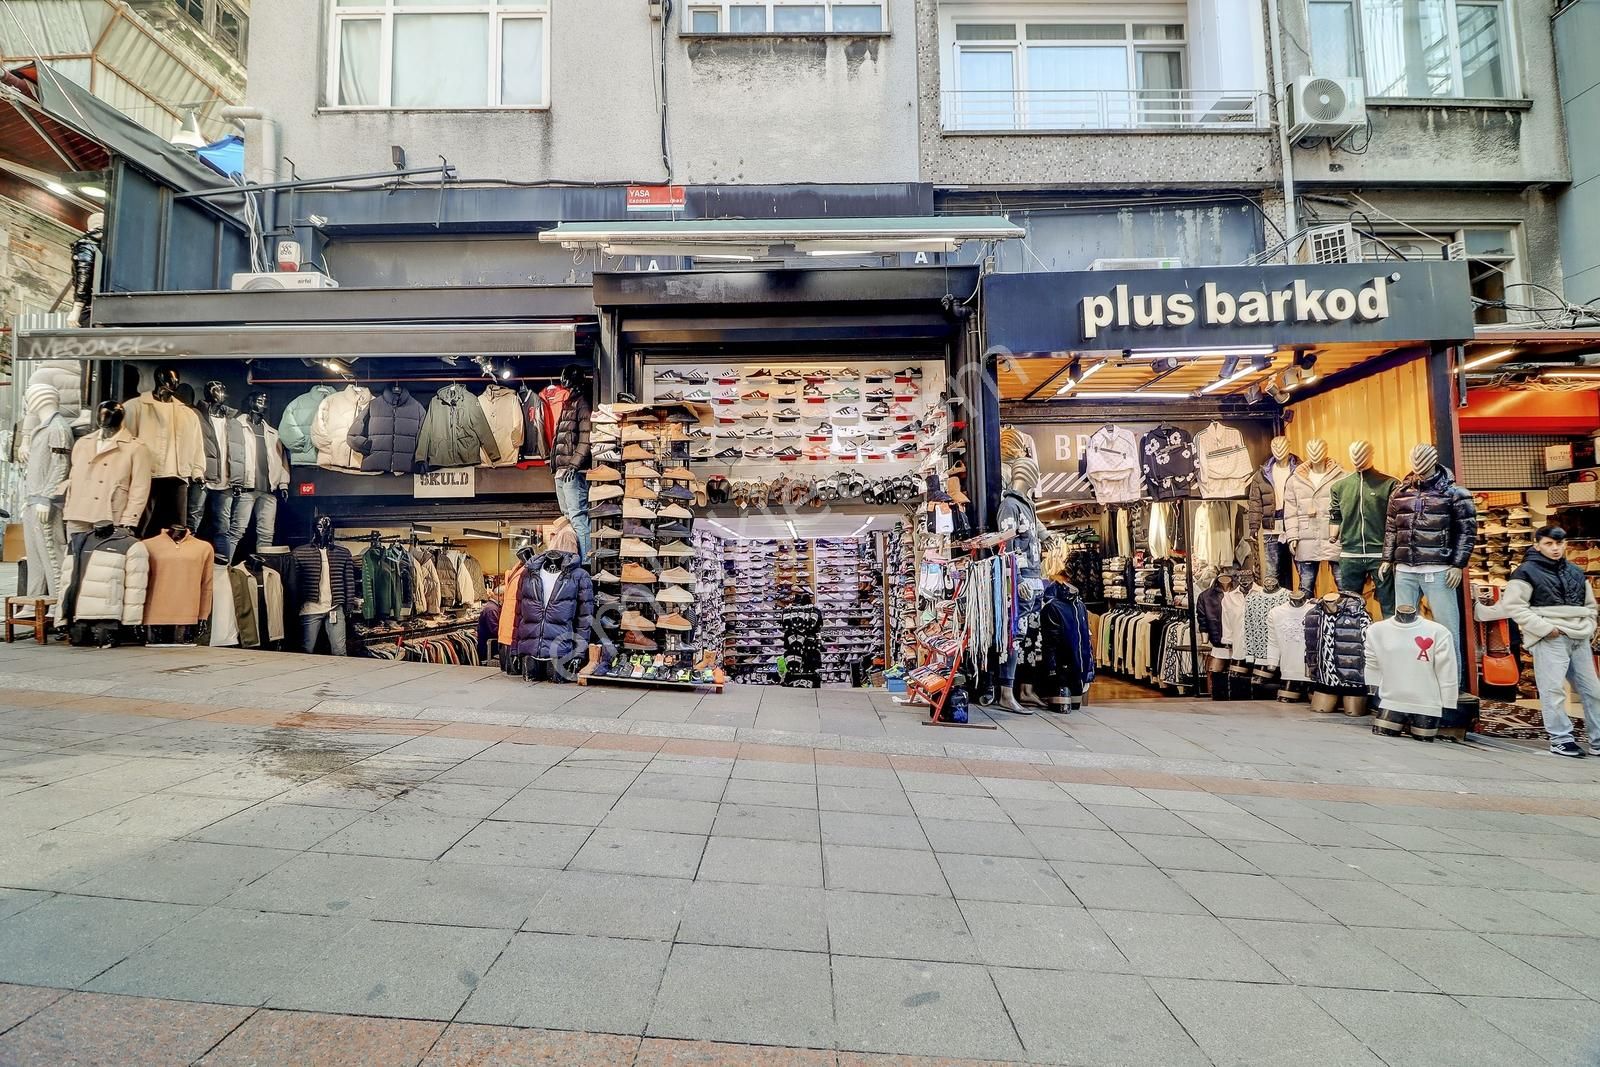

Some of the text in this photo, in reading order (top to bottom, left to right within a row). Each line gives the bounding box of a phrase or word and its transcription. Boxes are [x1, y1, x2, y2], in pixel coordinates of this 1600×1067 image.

[629, 189, 650, 197] YASA
[1082, 276, 1389, 339] plus barkod
